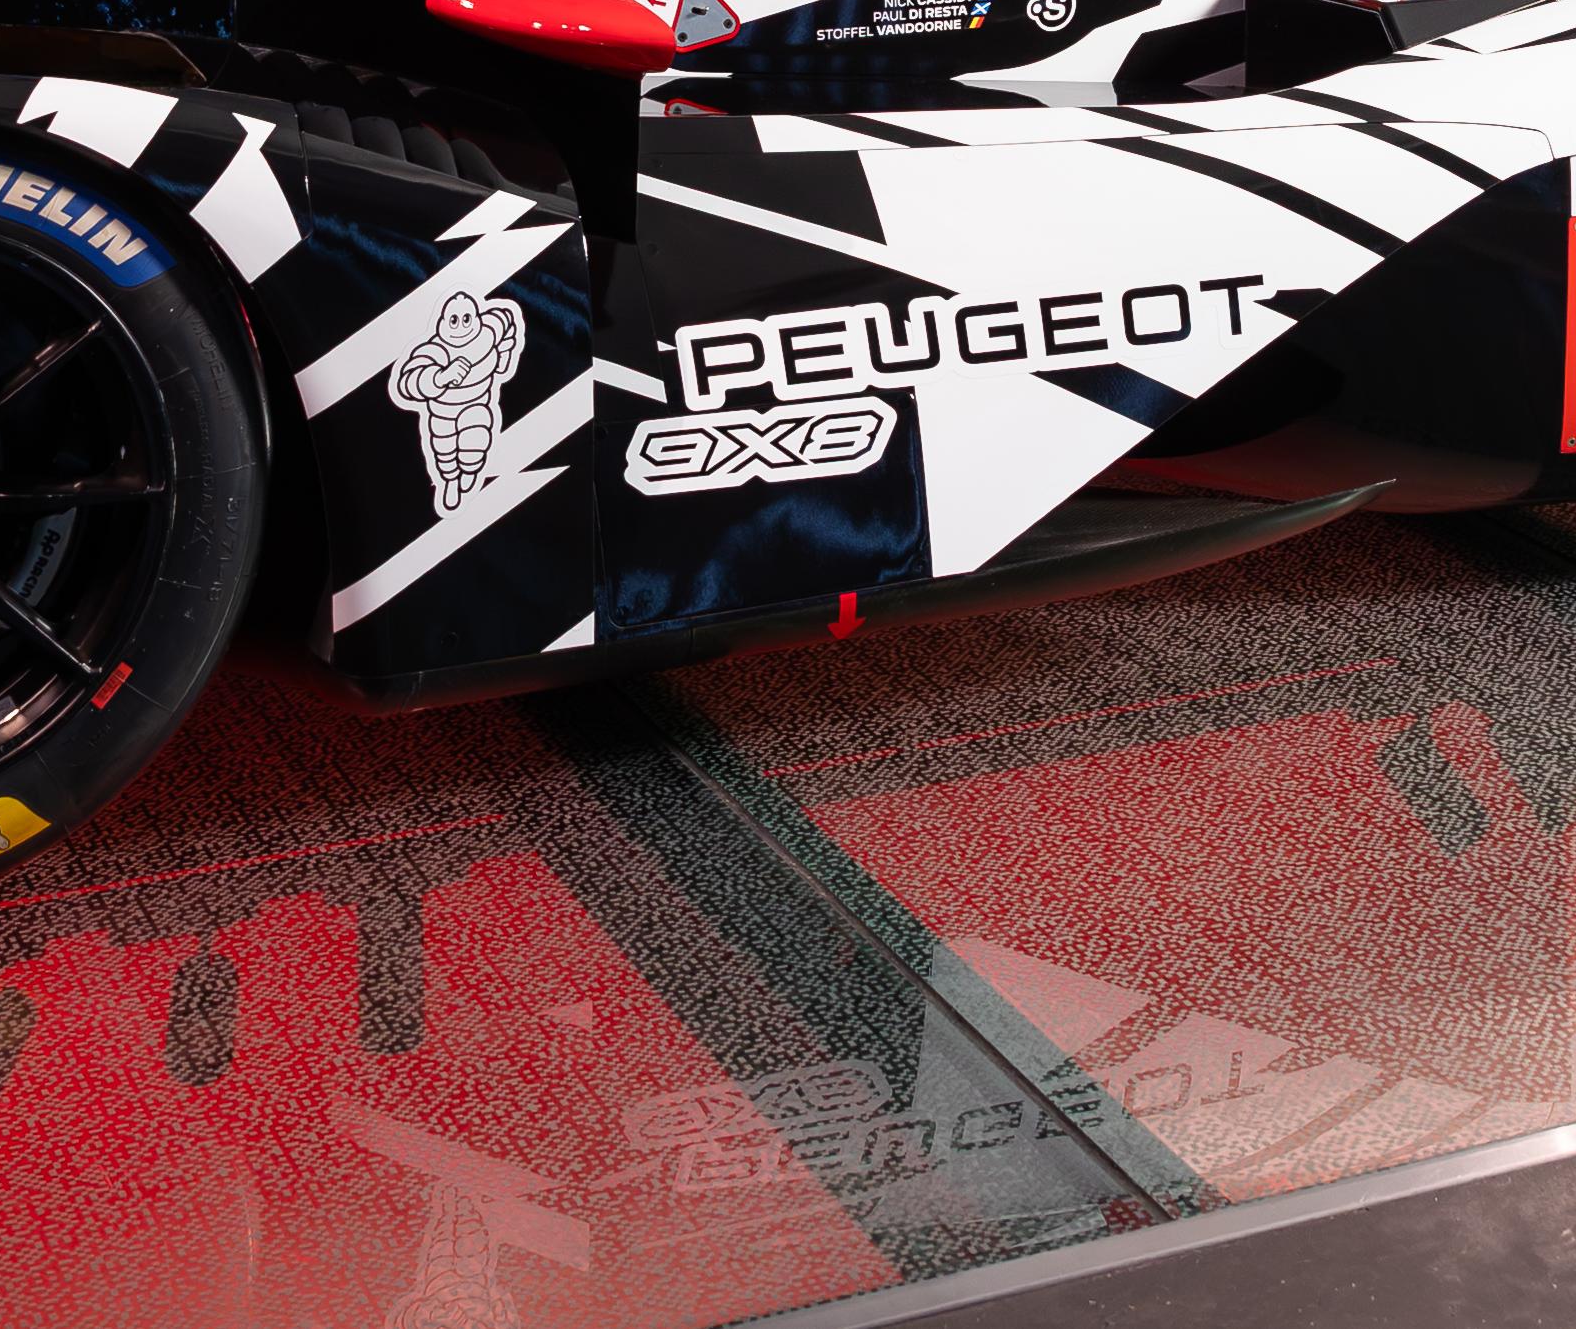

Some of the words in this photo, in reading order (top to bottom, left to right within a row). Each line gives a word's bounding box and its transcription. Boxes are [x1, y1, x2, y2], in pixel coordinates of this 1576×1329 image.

[817, 27, 873, 40] STOFFEL
[876, 20, 961, 36] VANDOORNE
[874, 9, 906, 22] PAUL
[909, 8, 922, 20] DI
[925, 5, 967, 18] RESTA
[692, 274, 1263, 395] PEUGEOT
[638, 409, 885, 481] 9X8
